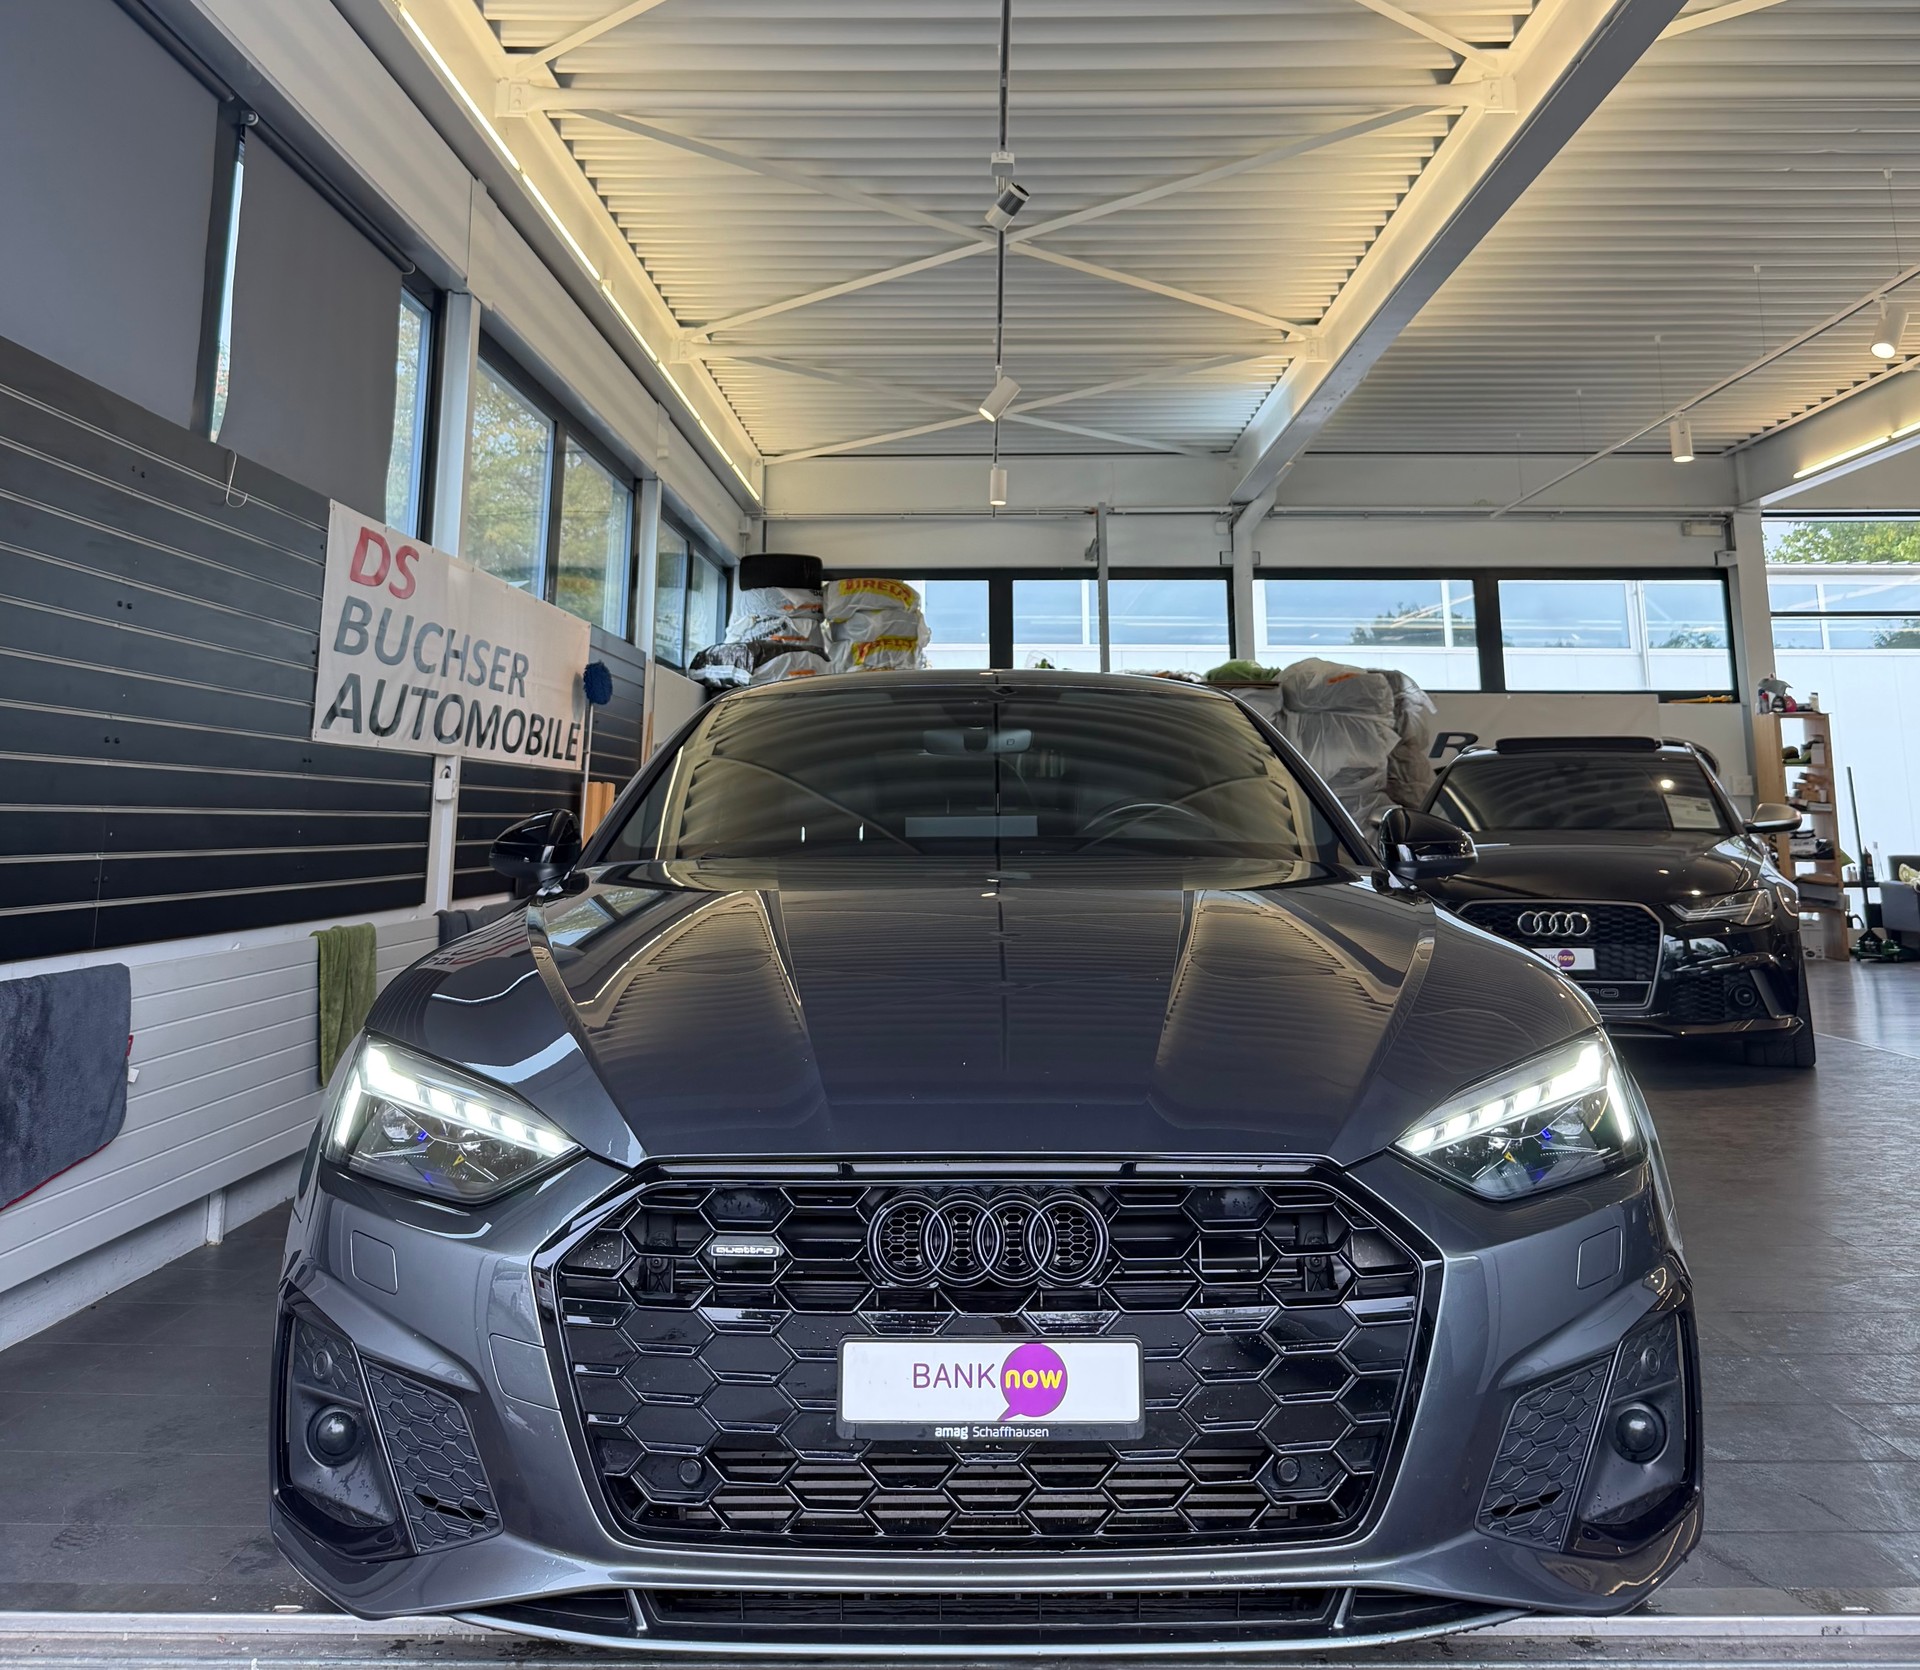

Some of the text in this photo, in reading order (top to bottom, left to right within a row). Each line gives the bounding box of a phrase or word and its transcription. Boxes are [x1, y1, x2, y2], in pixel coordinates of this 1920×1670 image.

[350, 527, 419, 599] DS
[333, 595, 529, 698] BUCHSER
[320, 673, 581, 762] AUTOMOBILE
[716, 1246, 774, 1255] quattro
[912, 1362, 1063, 1389] BANK now
[934, 1425, 1049, 1439] amag Schaffhausen
